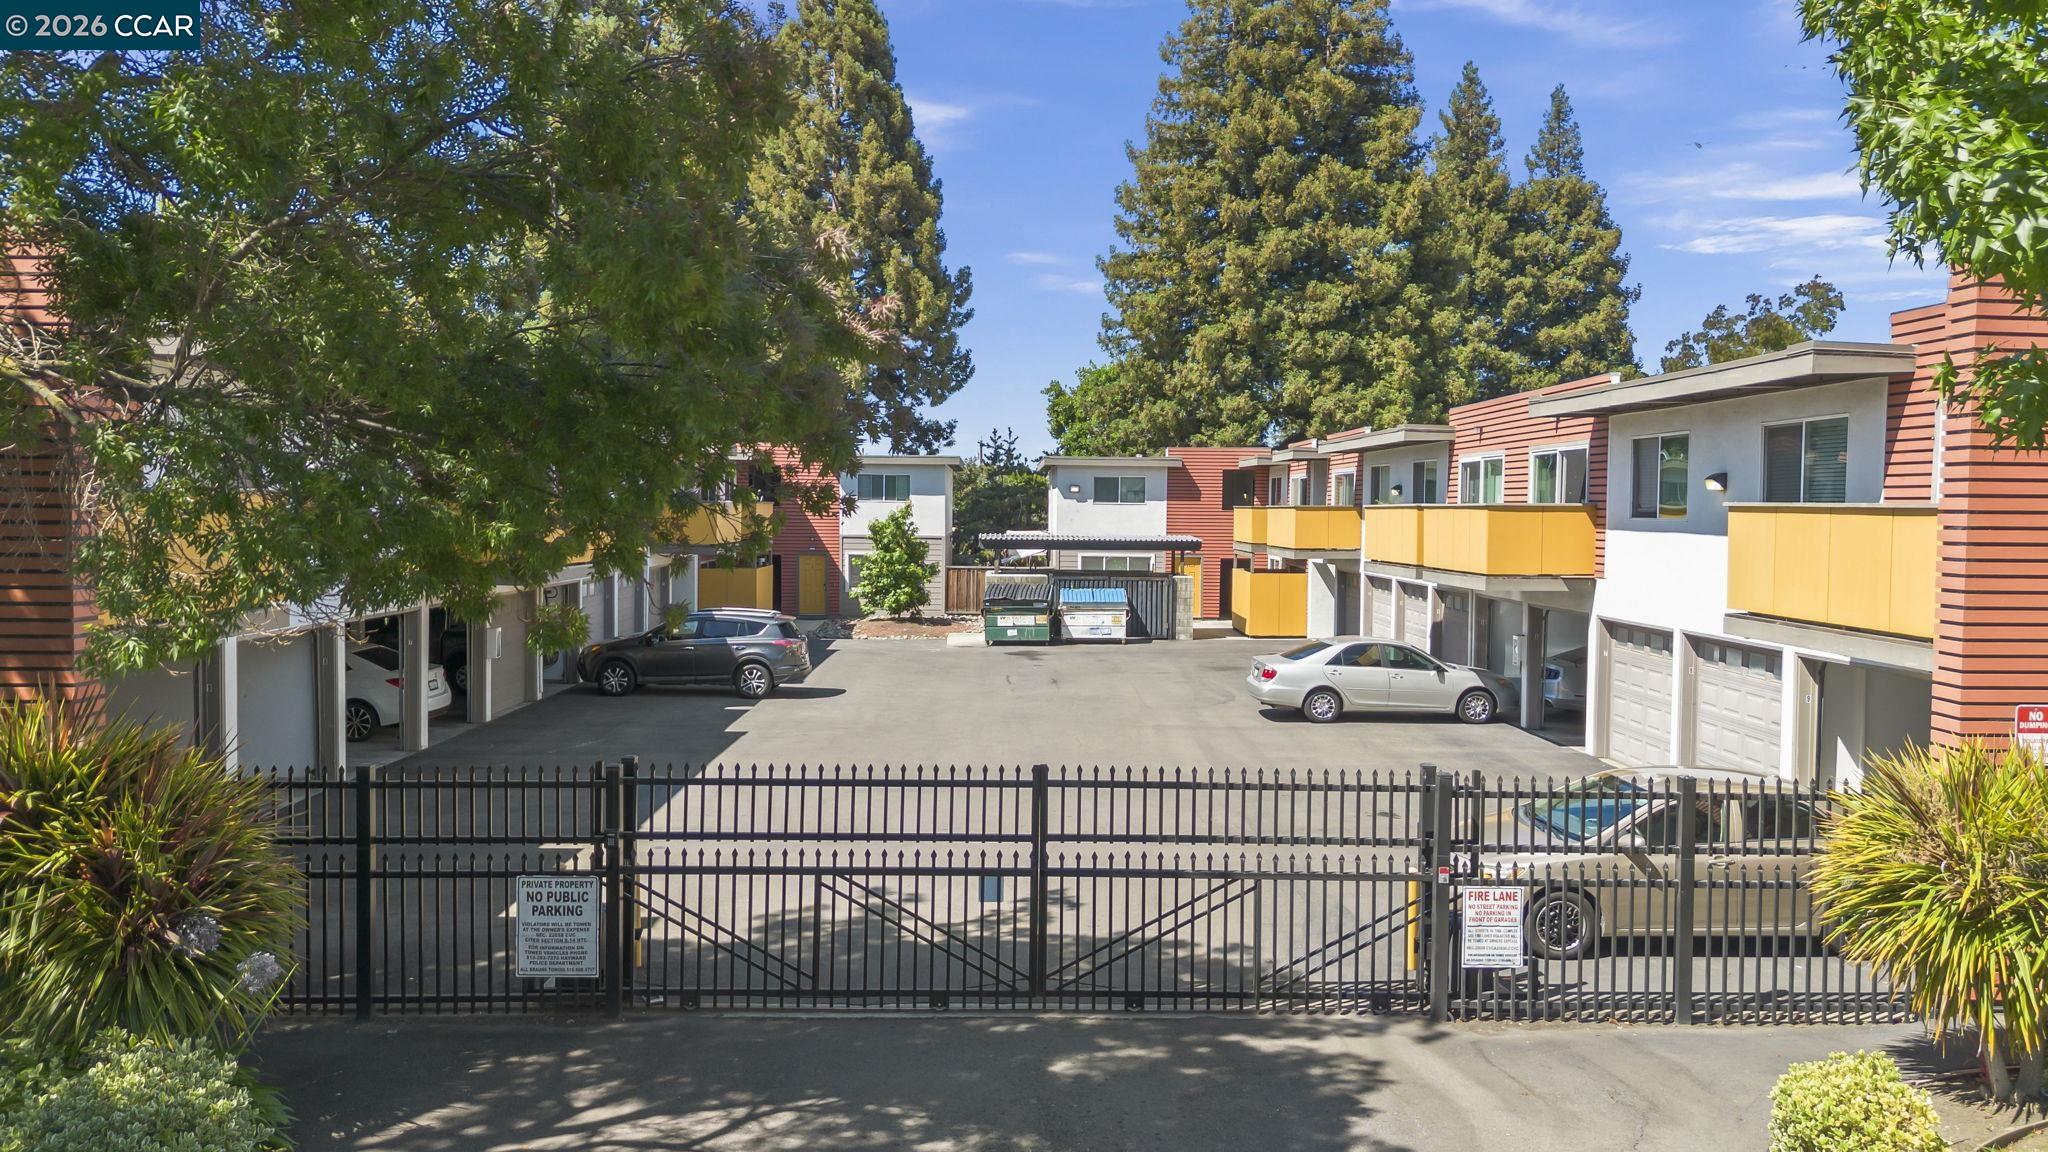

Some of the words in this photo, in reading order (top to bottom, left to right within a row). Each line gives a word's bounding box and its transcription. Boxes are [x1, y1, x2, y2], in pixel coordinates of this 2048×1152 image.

[2029, 712, 2044, 721] NO
[521, 880, 552, 888] PRIVATE
[555, 880, 594, 888] PROPERTY
[526, 891, 542, 902] NO
[547, 891, 589, 902] PUBLIC
[1468, 891, 1490, 901] FIRE
[1493, 891, 1518, 901] LANE
[532, 905, 583, 916] PARKING
